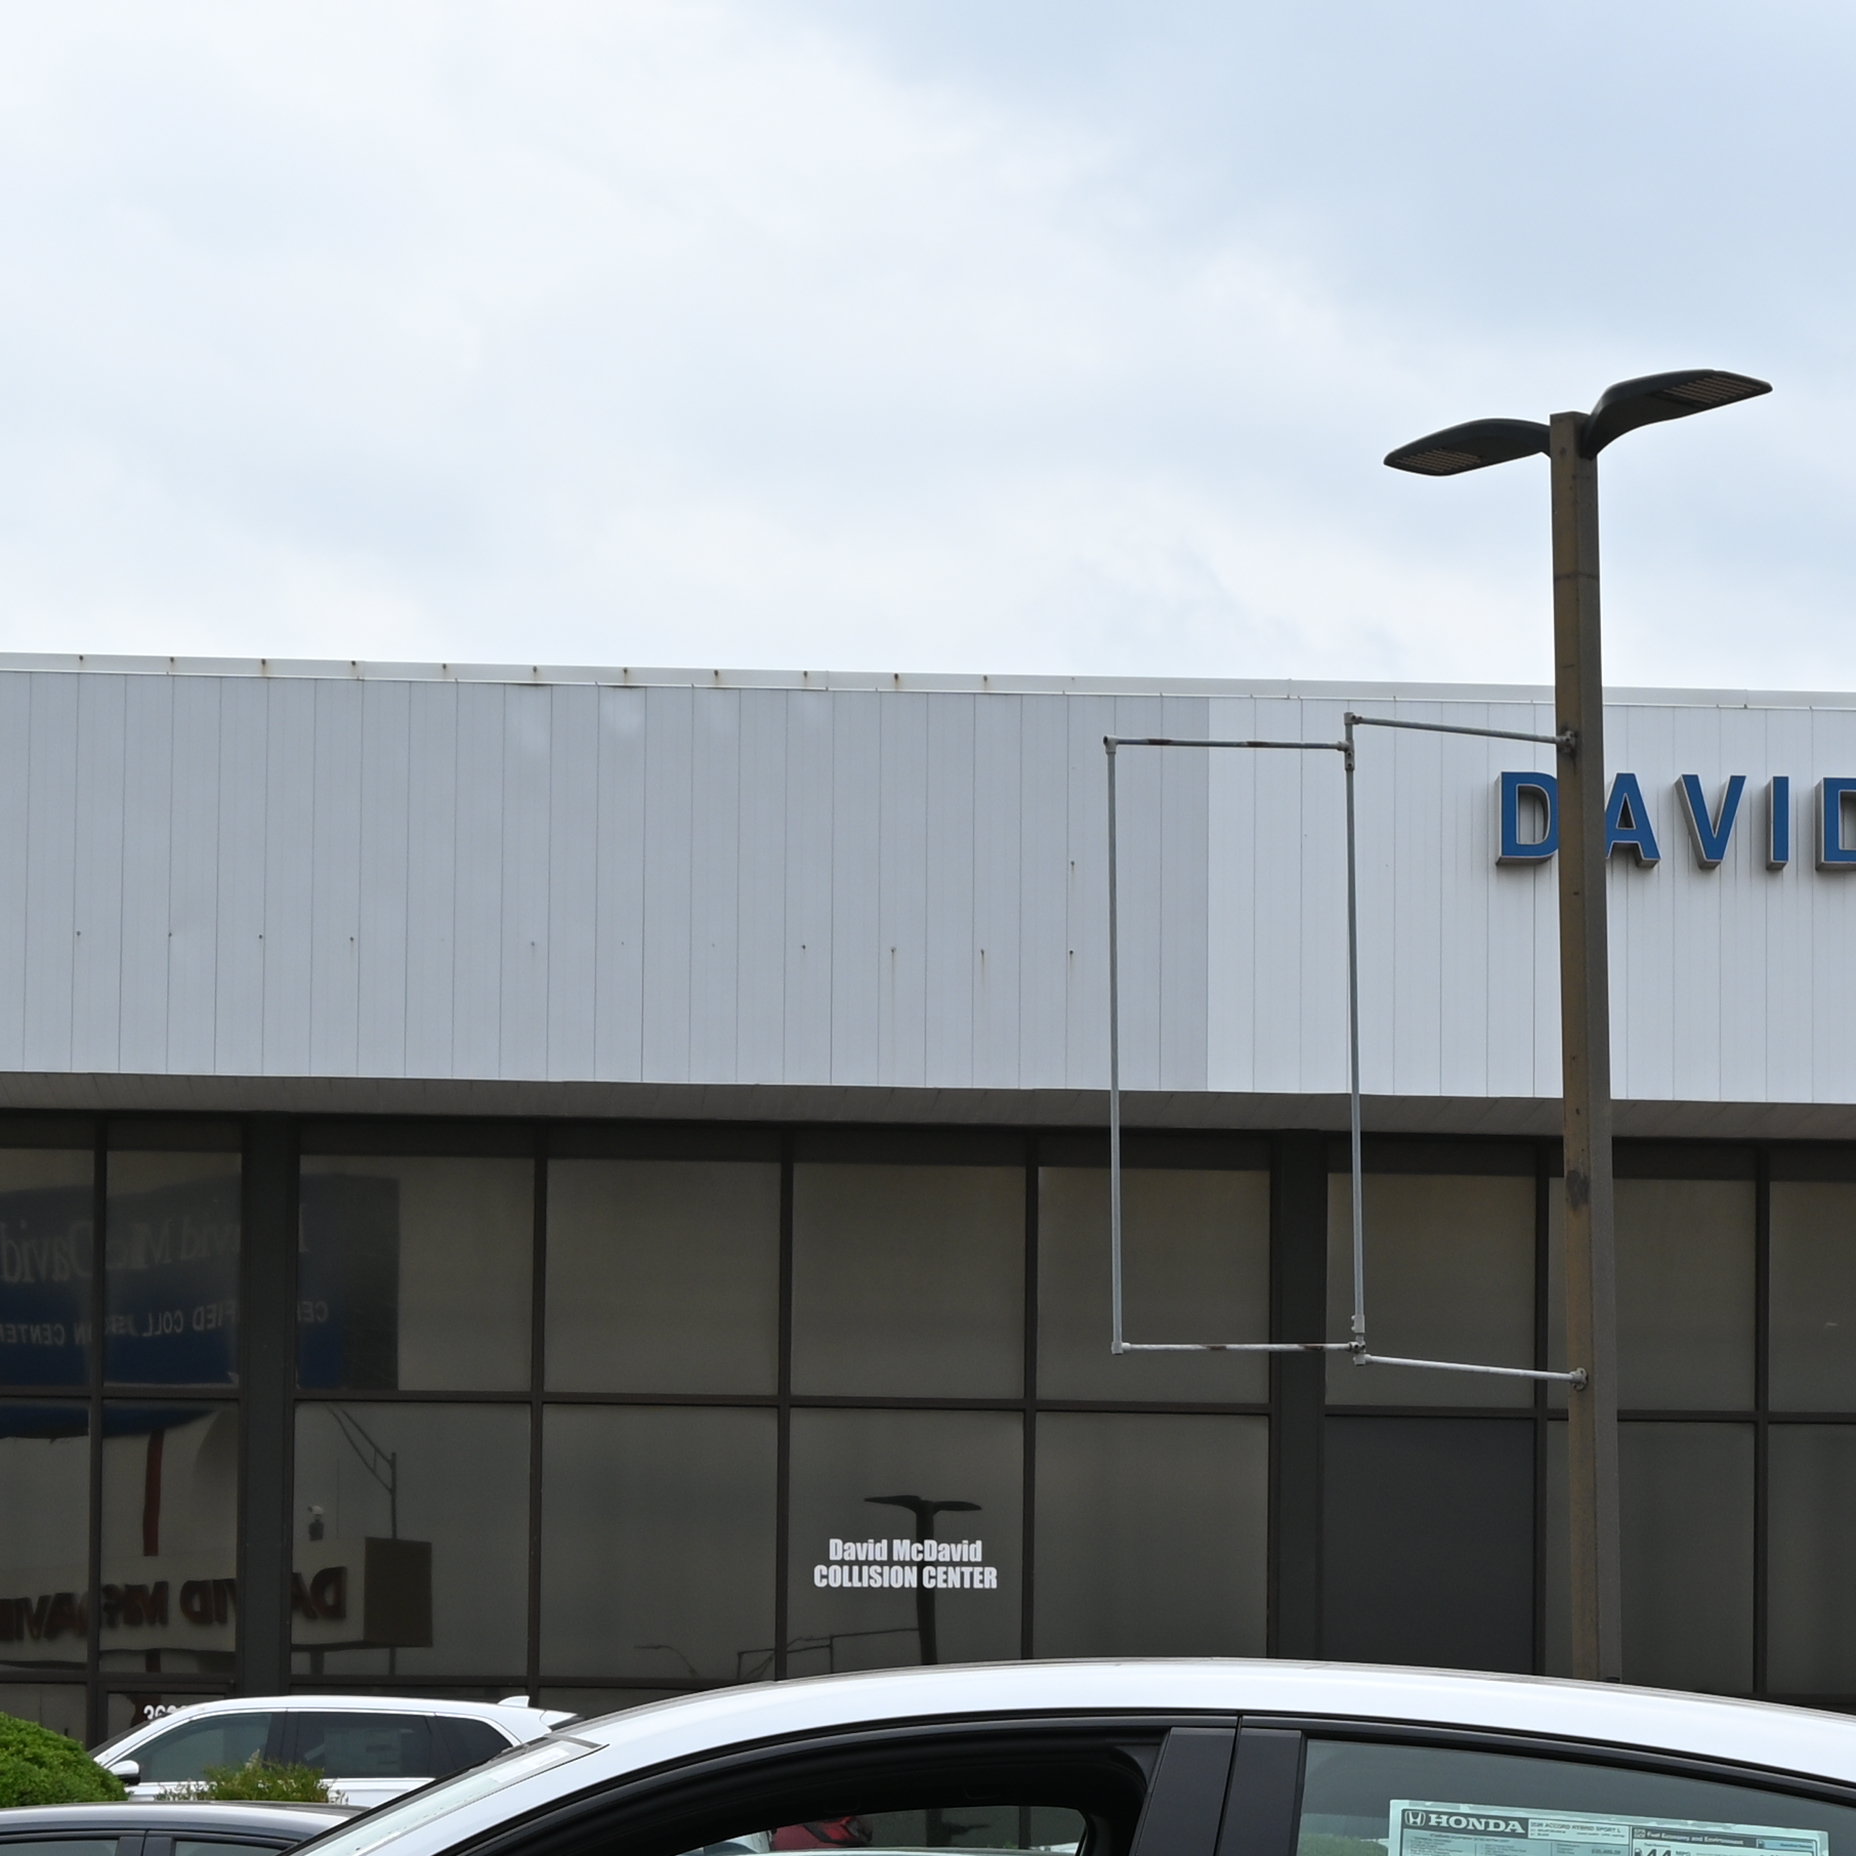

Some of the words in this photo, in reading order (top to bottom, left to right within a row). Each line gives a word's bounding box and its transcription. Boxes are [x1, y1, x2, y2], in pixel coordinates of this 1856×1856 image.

[829, 1538, 888, 1562] David
[893, 1539, 982, 1562] McDavid
[813, 1564, 918, 1588] COLLISION
[922, 1566, 998, 1589] CENTER
[1428, 1814, 1526, 1834] HONDA
